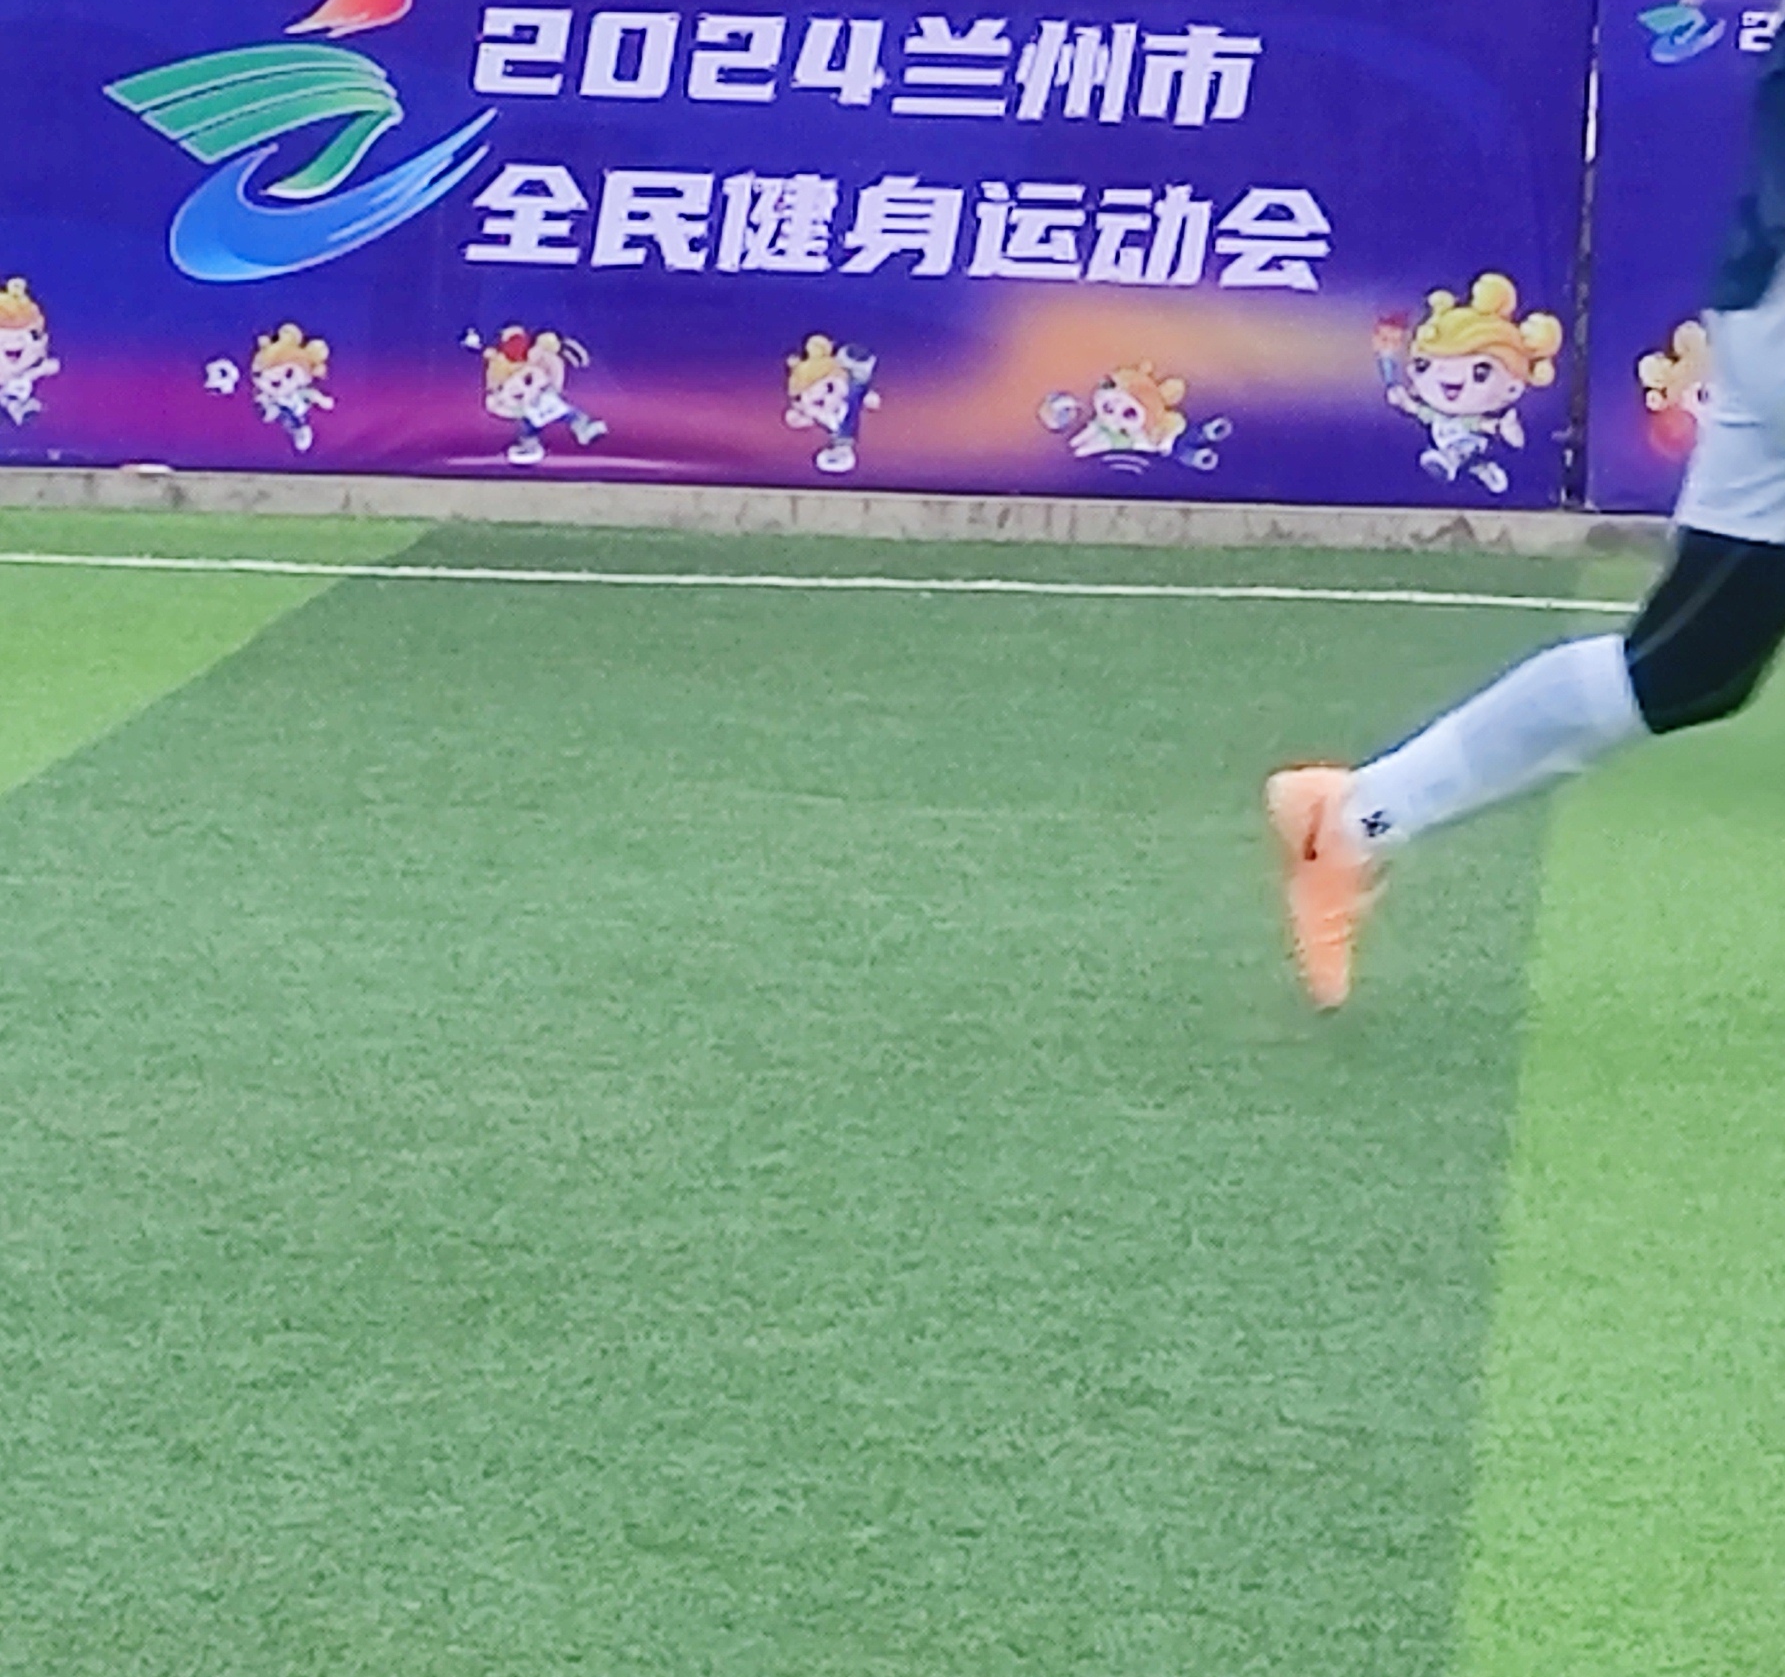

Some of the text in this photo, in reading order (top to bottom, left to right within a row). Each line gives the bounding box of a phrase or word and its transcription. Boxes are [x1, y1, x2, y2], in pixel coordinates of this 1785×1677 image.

[471, 6, 1263, 126] 2024兰州市
[464, 163, 1335, 292] 全民健身运动会
